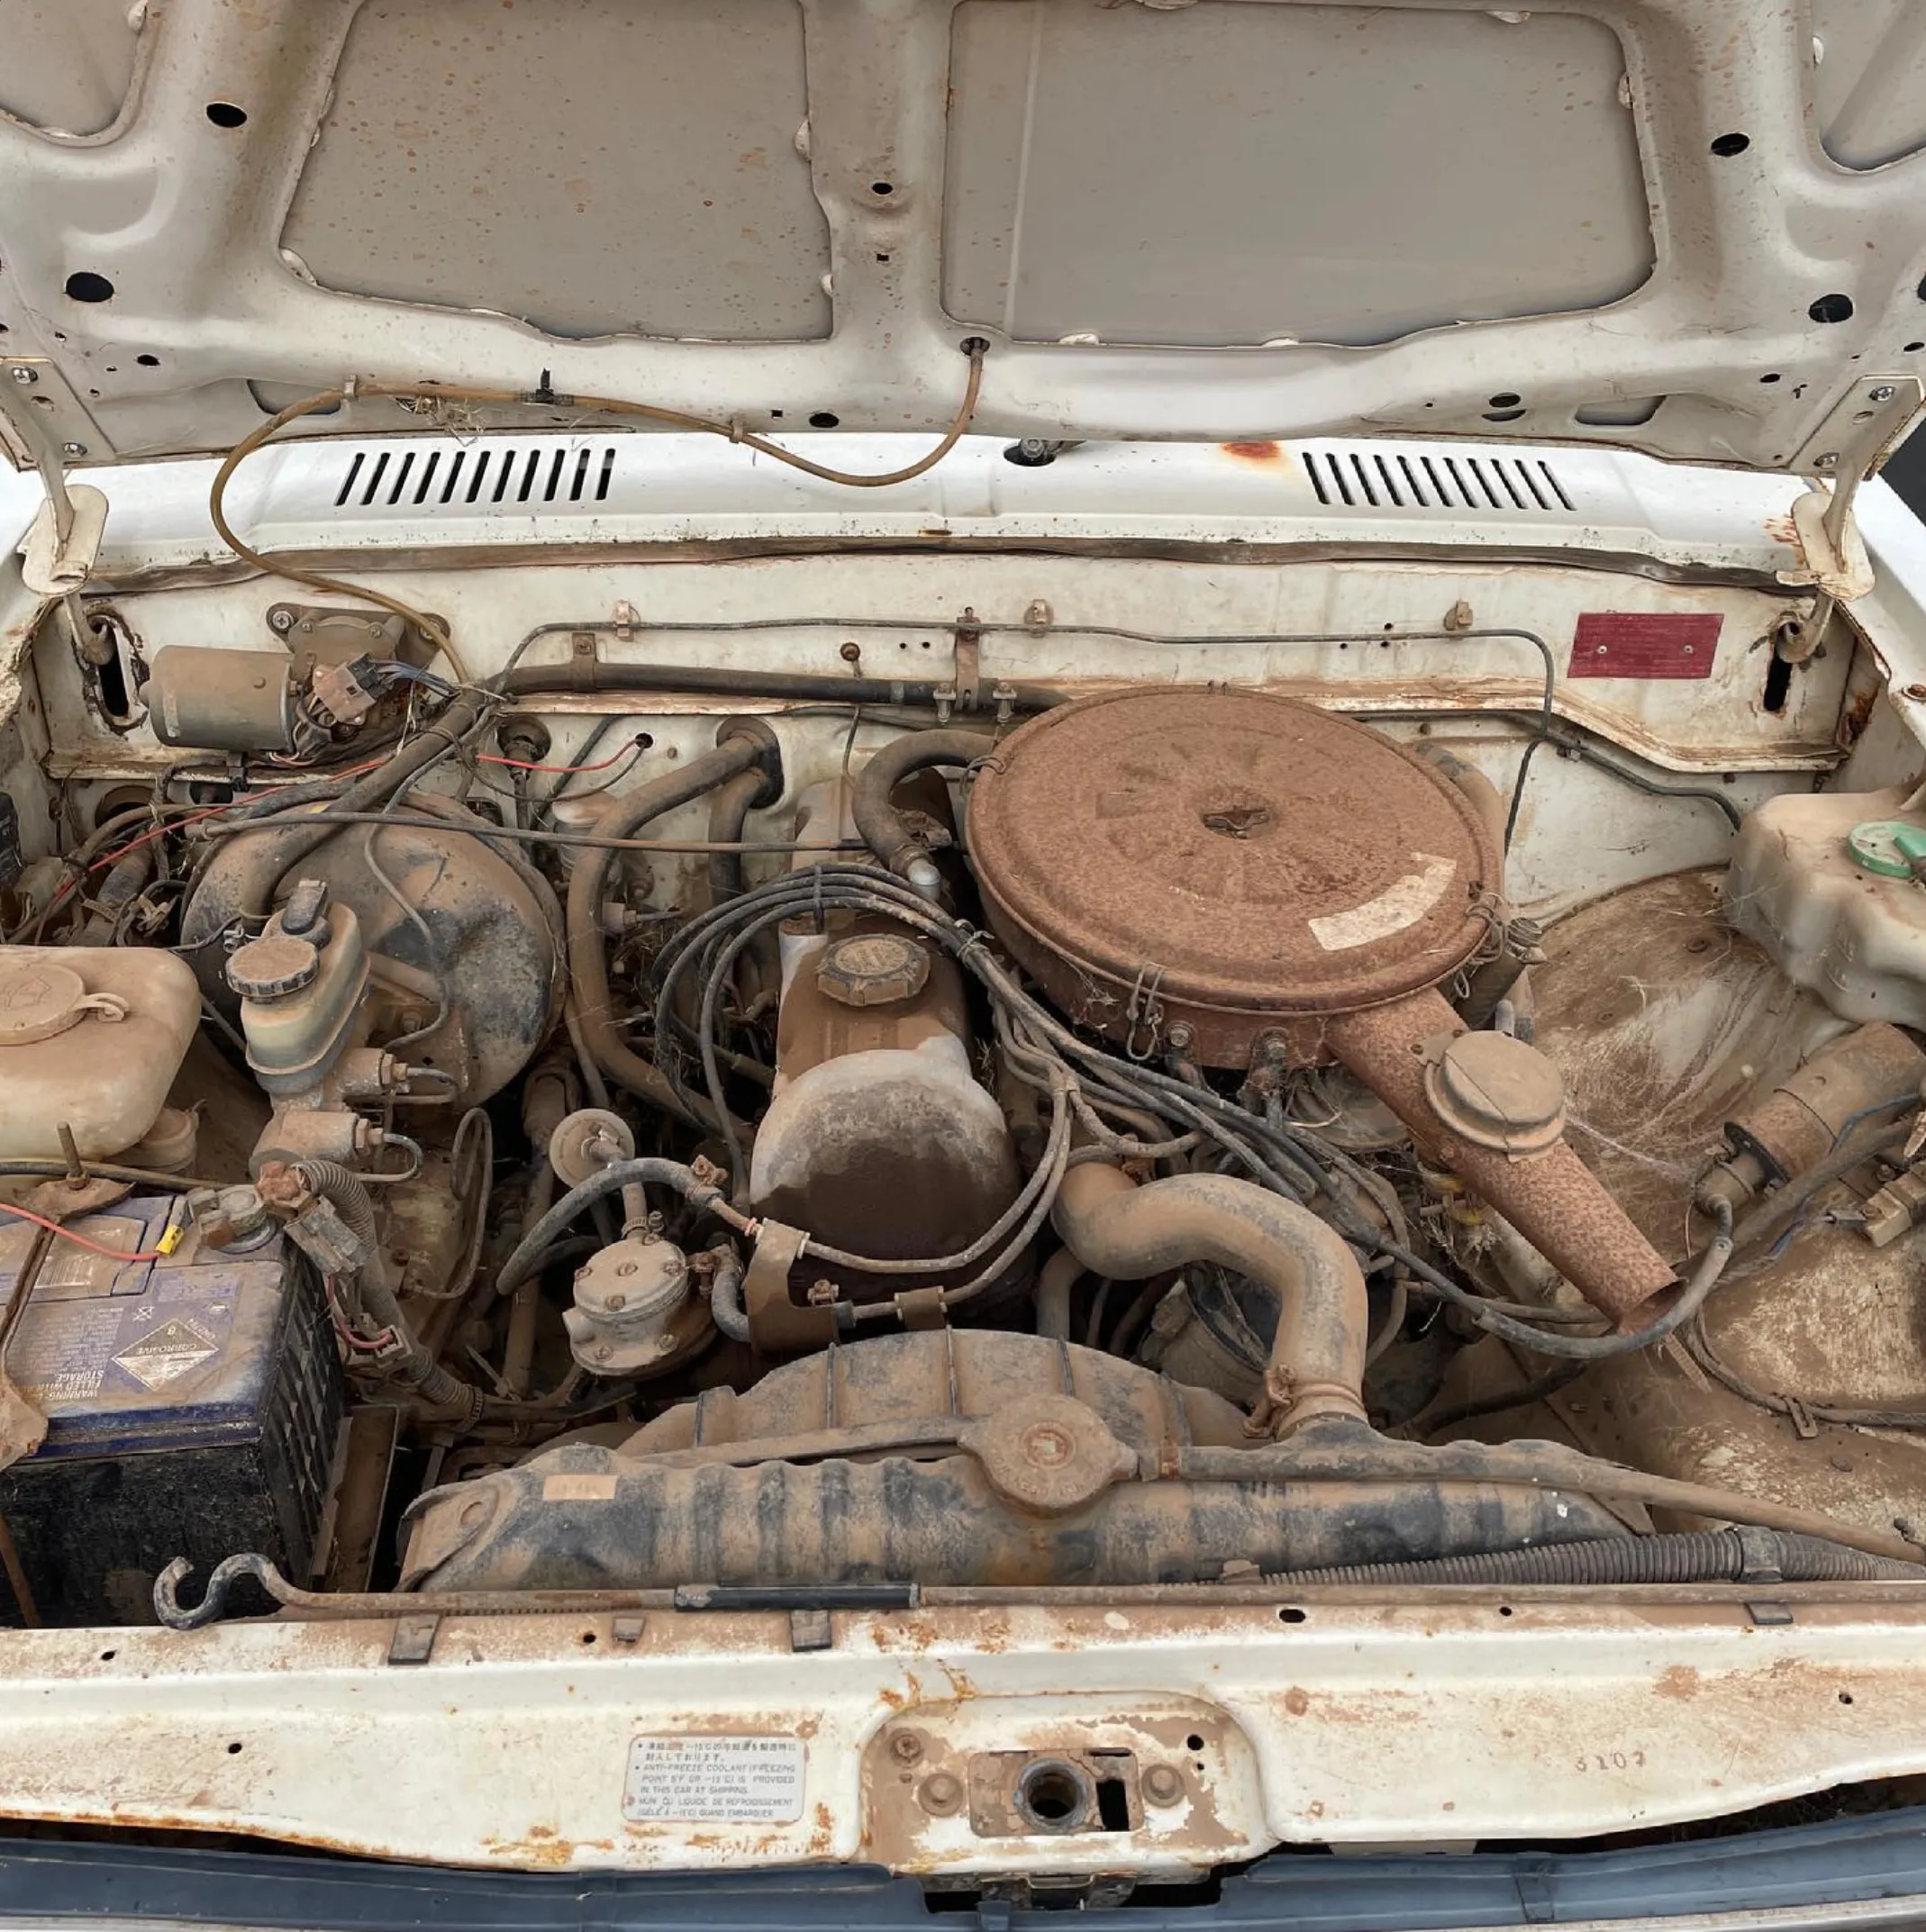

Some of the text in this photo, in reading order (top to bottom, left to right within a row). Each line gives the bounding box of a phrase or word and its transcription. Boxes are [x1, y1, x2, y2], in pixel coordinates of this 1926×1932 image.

[138, 1343, 197, 1355] CORROSIVE
[66, 1379, 101, 1390] FILLED
[643, 1764, 703, 1773] ANTI-FREEZE
[706, 1764, 747, 1773] COOLANT
[641, 1774, 668, 1783] POINT
[752, 1775, 795, 1784] PROVIDED
[652, 1785, 671, 1793] THIS
[674, 1785, 692, 1794] CAR
[695, 1785, 706, 1793] AT
